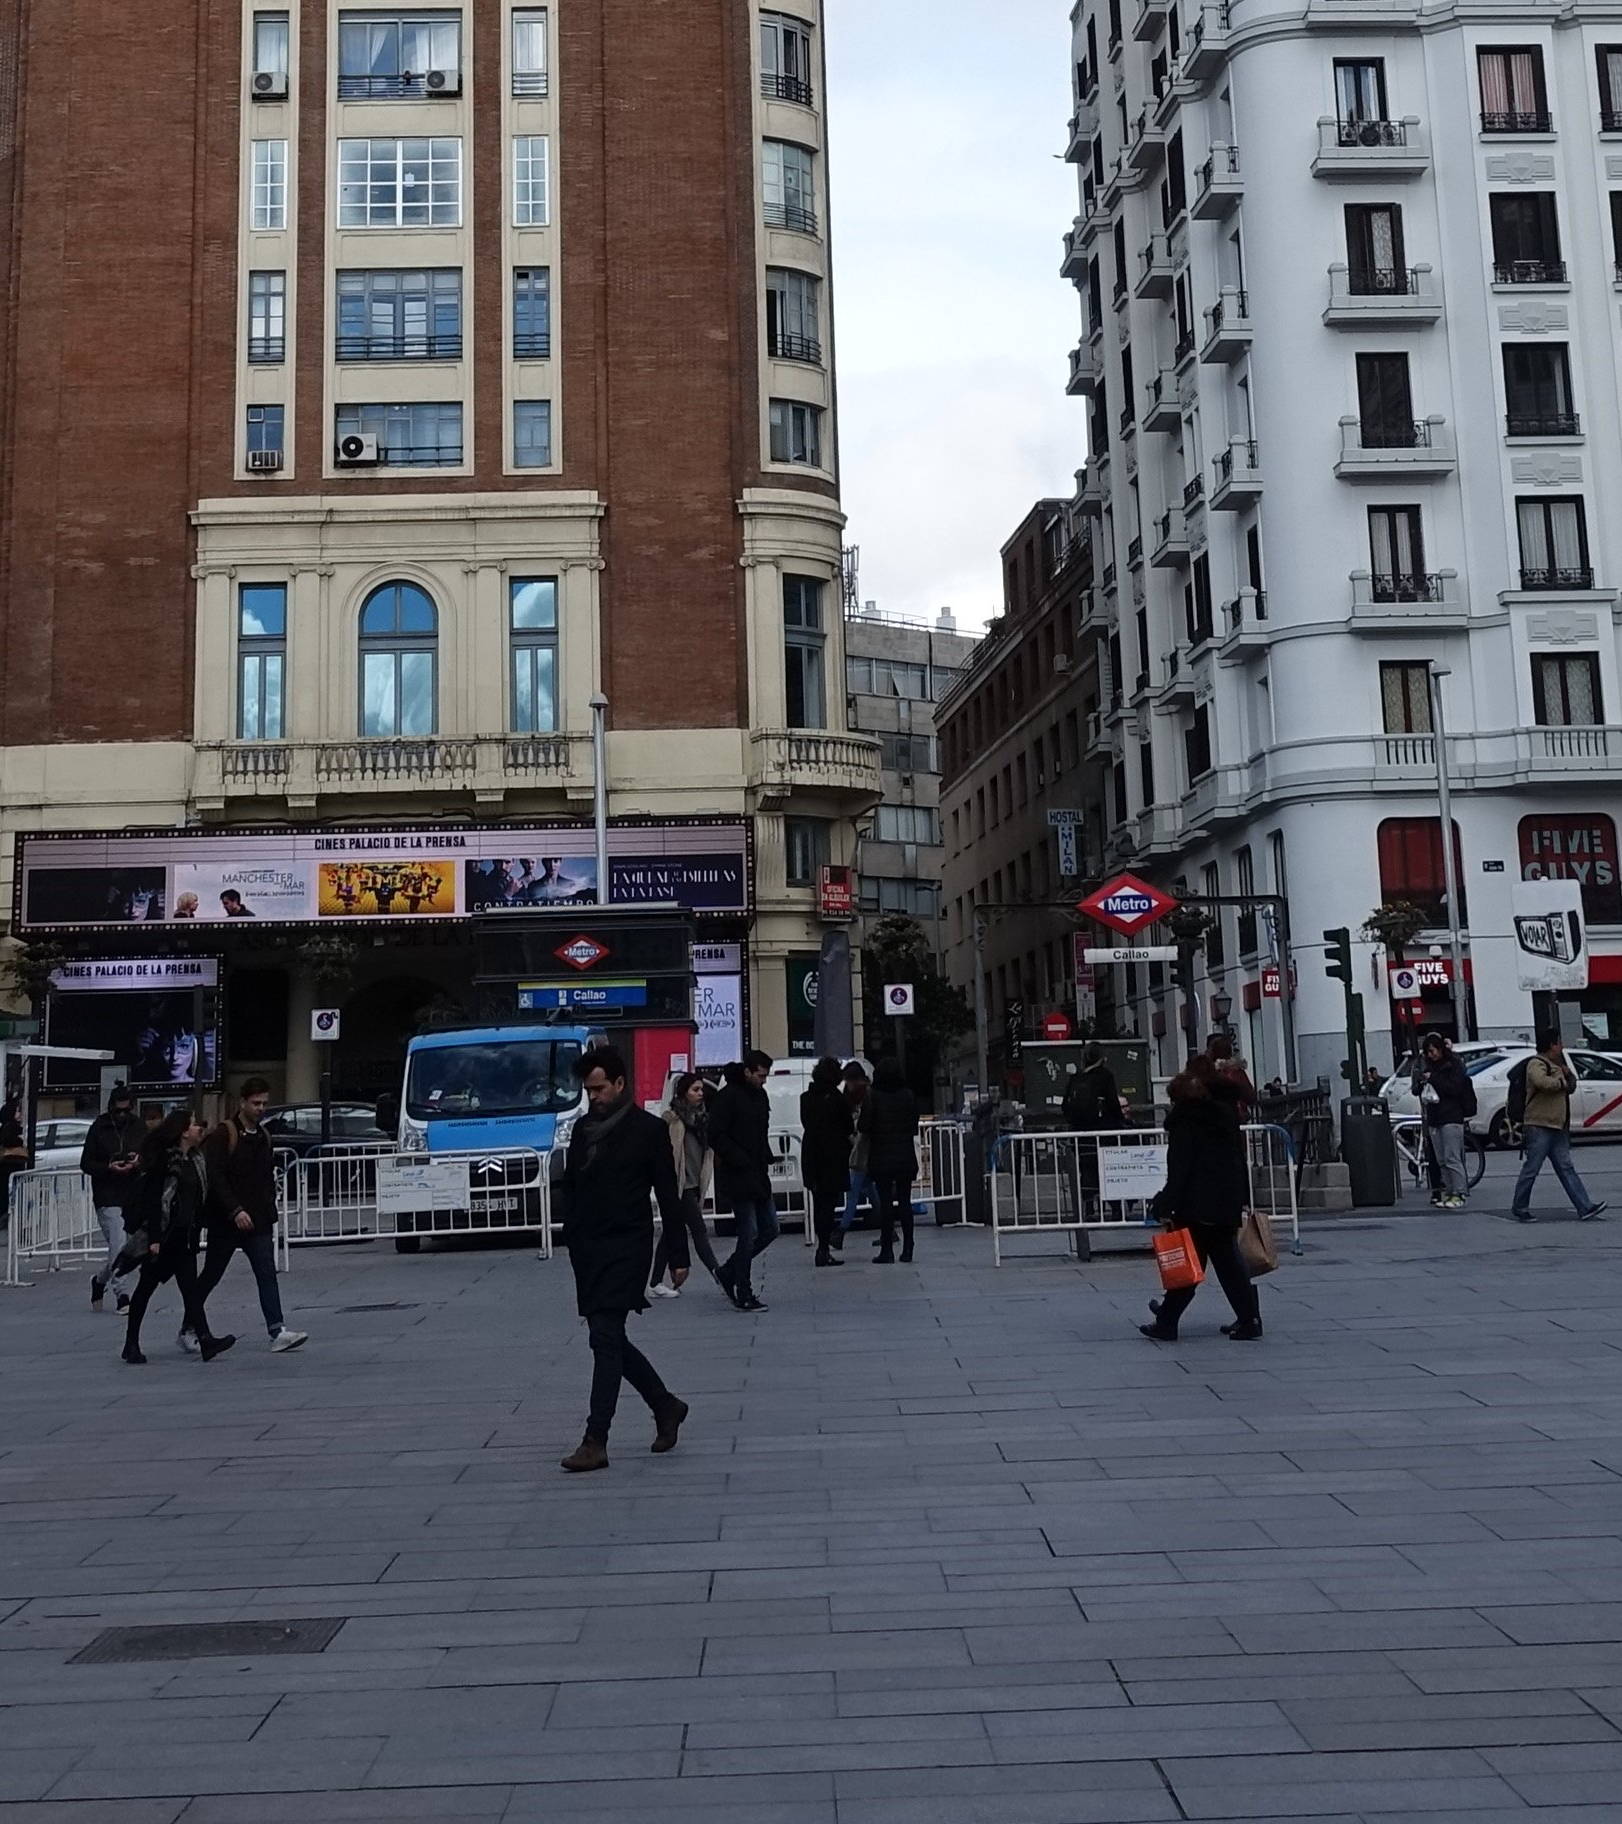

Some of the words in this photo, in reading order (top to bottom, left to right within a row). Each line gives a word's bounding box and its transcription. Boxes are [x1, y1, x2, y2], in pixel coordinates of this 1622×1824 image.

[1049, 810, 1082, 823] HOSTAL
[315, 838, 346, 851] CINES
[349, 837, 391, 850] PALACIO
[394, 836, 408, 849] DE
[410, 836, 423, 848] LA
[426, 835, 466, 848] PRENSA
[1532, 829, 1604, 855] FIVE
[1062, 831, 1075, 875] MILAN
[222, 873, 294, 884] MANCHESTER
[1107, 896, 1149, 912] Metro
[568, 947, 596, 956] Metro
[1113, 949, 1149, 961] Callao
[63, 966, 92, 978] CINES
[95, 965, 133, 977] PALACIO
[136, 964, 148, 976] DE
[151, 964, 163, 975] LA
[165, 963, 202, 975] PRENSA
[1414, 962, 1444, 974] FIVE
[573, 989, 607, 1001] Callao
[698, 1003, 735, 1017] MAR
